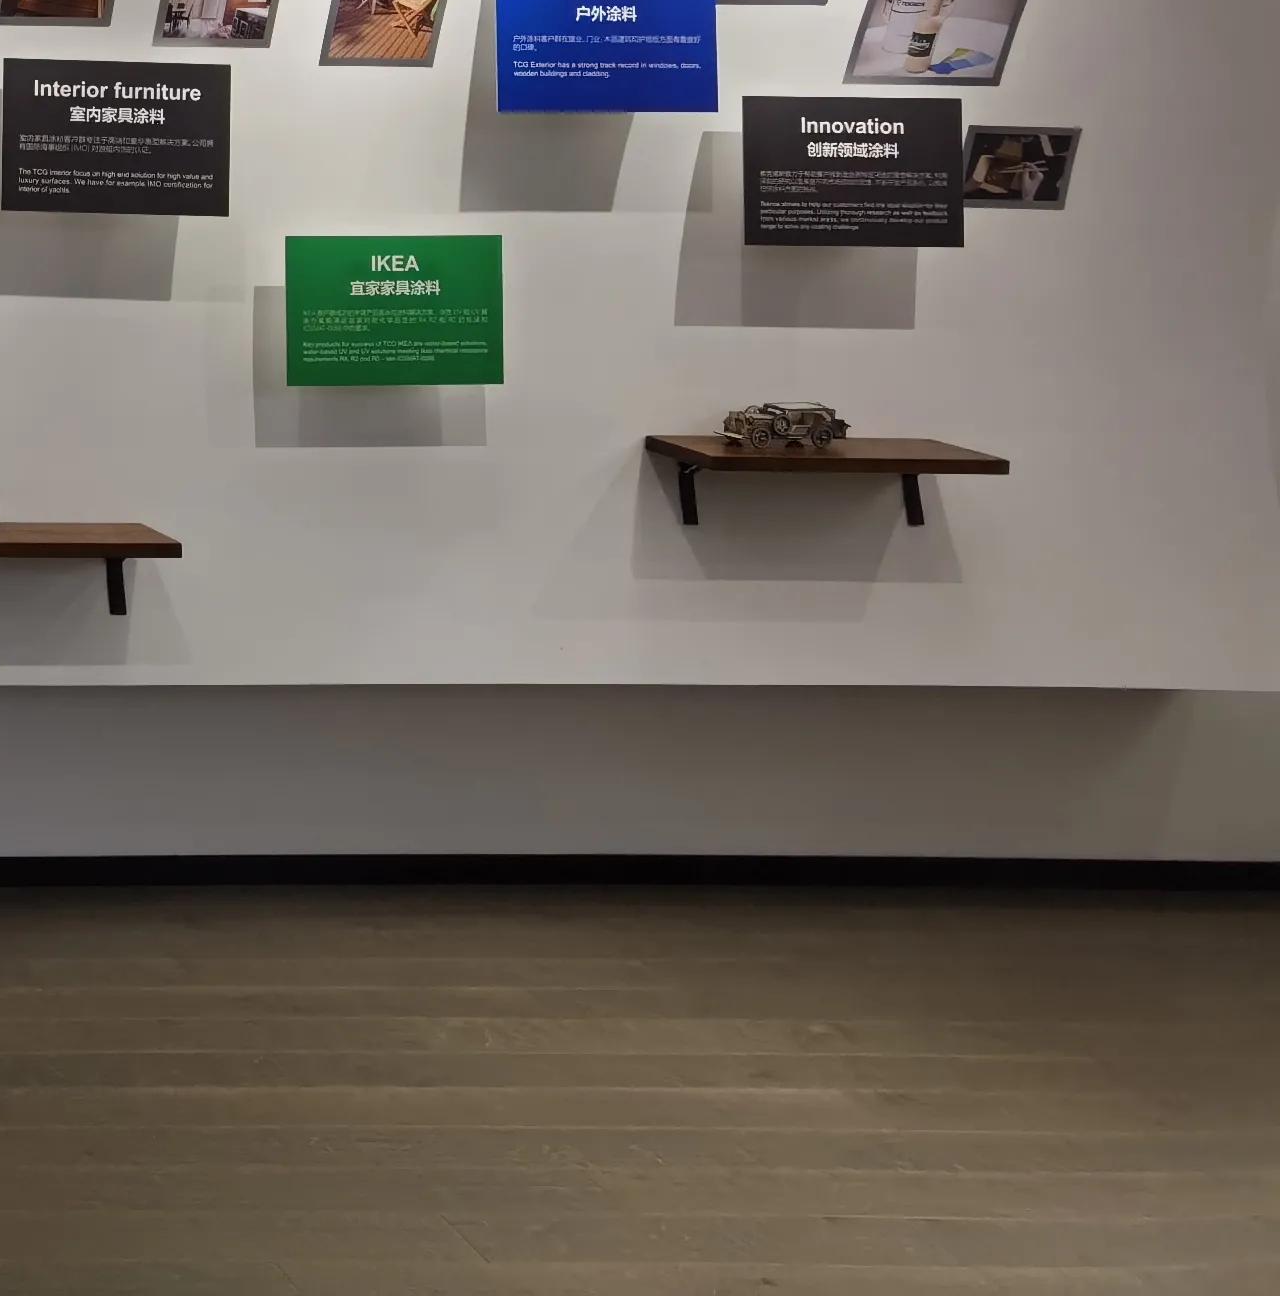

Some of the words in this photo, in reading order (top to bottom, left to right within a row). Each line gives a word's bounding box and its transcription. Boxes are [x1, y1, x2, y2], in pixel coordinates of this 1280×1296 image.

[574, 4, 637, 22] 户外涂料
[34, 78, 108, 98] Interior
[113, 81, 201, 101] furniture
[69, 105, 165, 125] 室内家具涂料
[800, 116, 904, 134] Innovation
[806, 141, 899, 158] 创新领域涂料
[371, 254, 419, 271] IKEA
[349, 279, 440, 296] 宜家家具涂料
